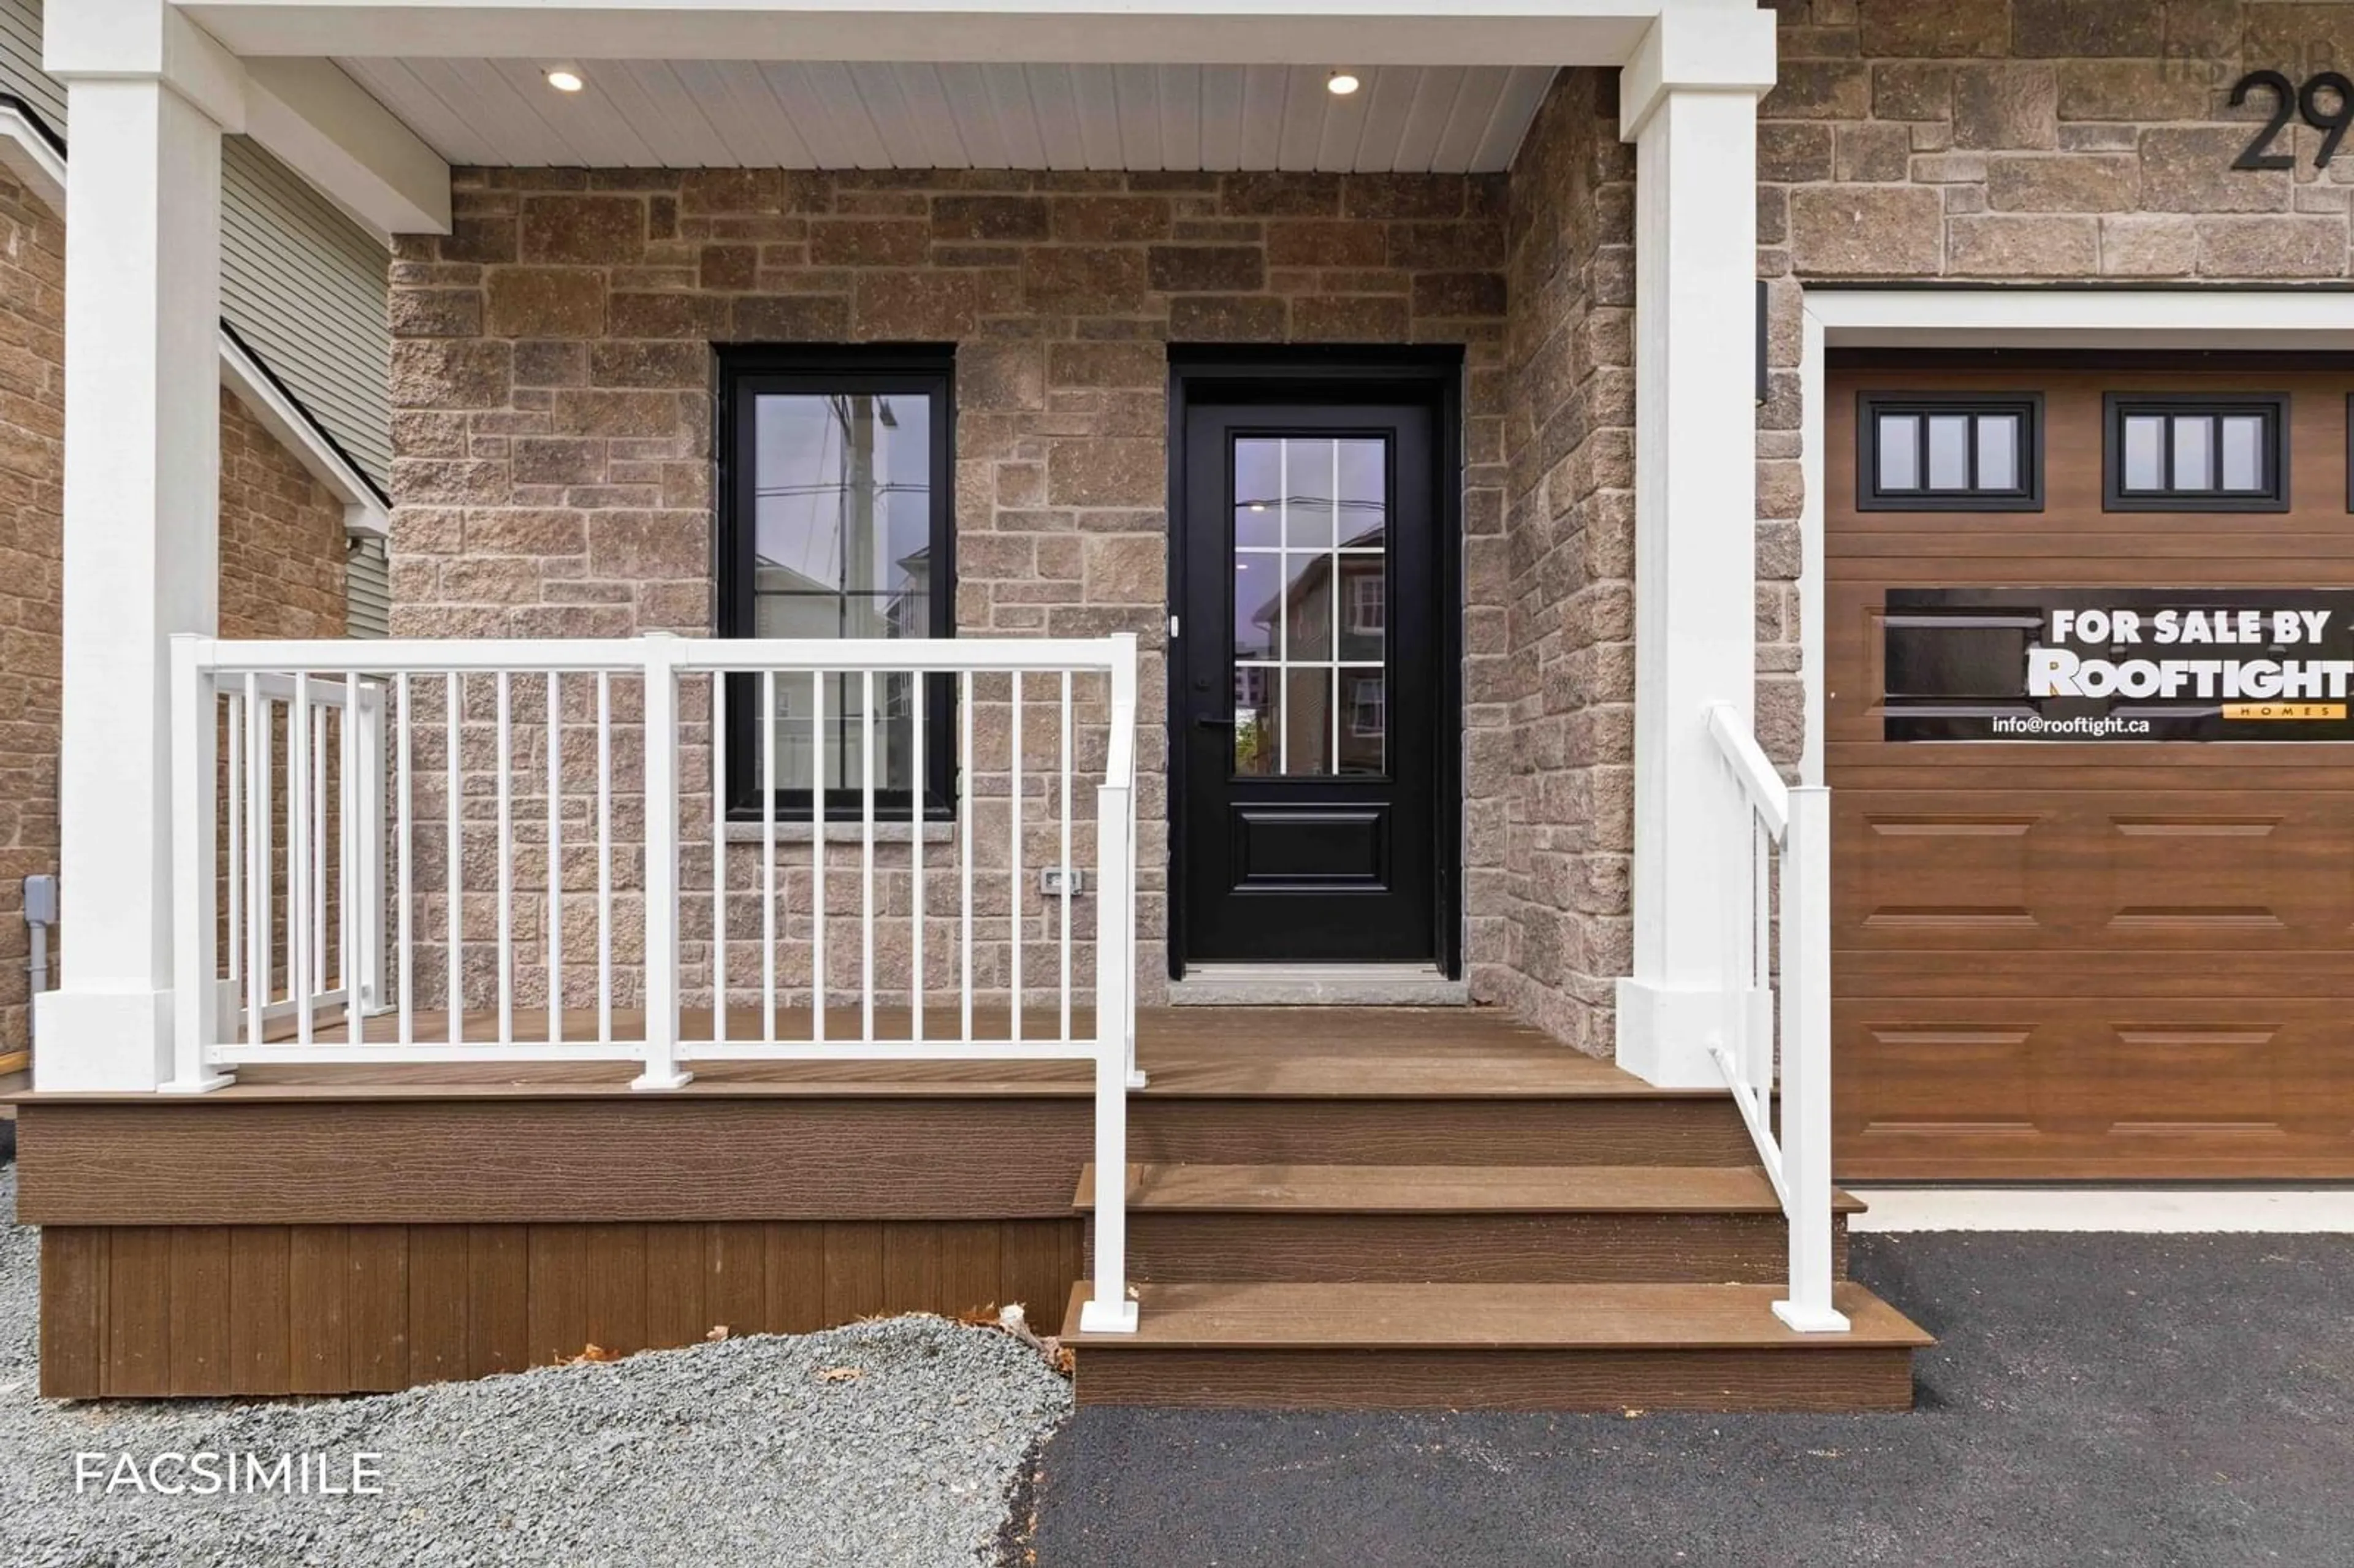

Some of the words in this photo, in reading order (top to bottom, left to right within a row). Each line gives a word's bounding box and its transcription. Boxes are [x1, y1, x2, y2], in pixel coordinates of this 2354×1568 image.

[2229, 69, 2354, 170] 29
[2052, 610, 2141, 643] FOR
[2154, 610, 2261, 644] SALE
[2272, 611, 2332, 643] BY
[2028, 648, 2354, 698] ROOFTIGHT
[1992, 716, 2150, 736] info@rooftight.ca
[2241, 707, 2329, 716] HOMES
